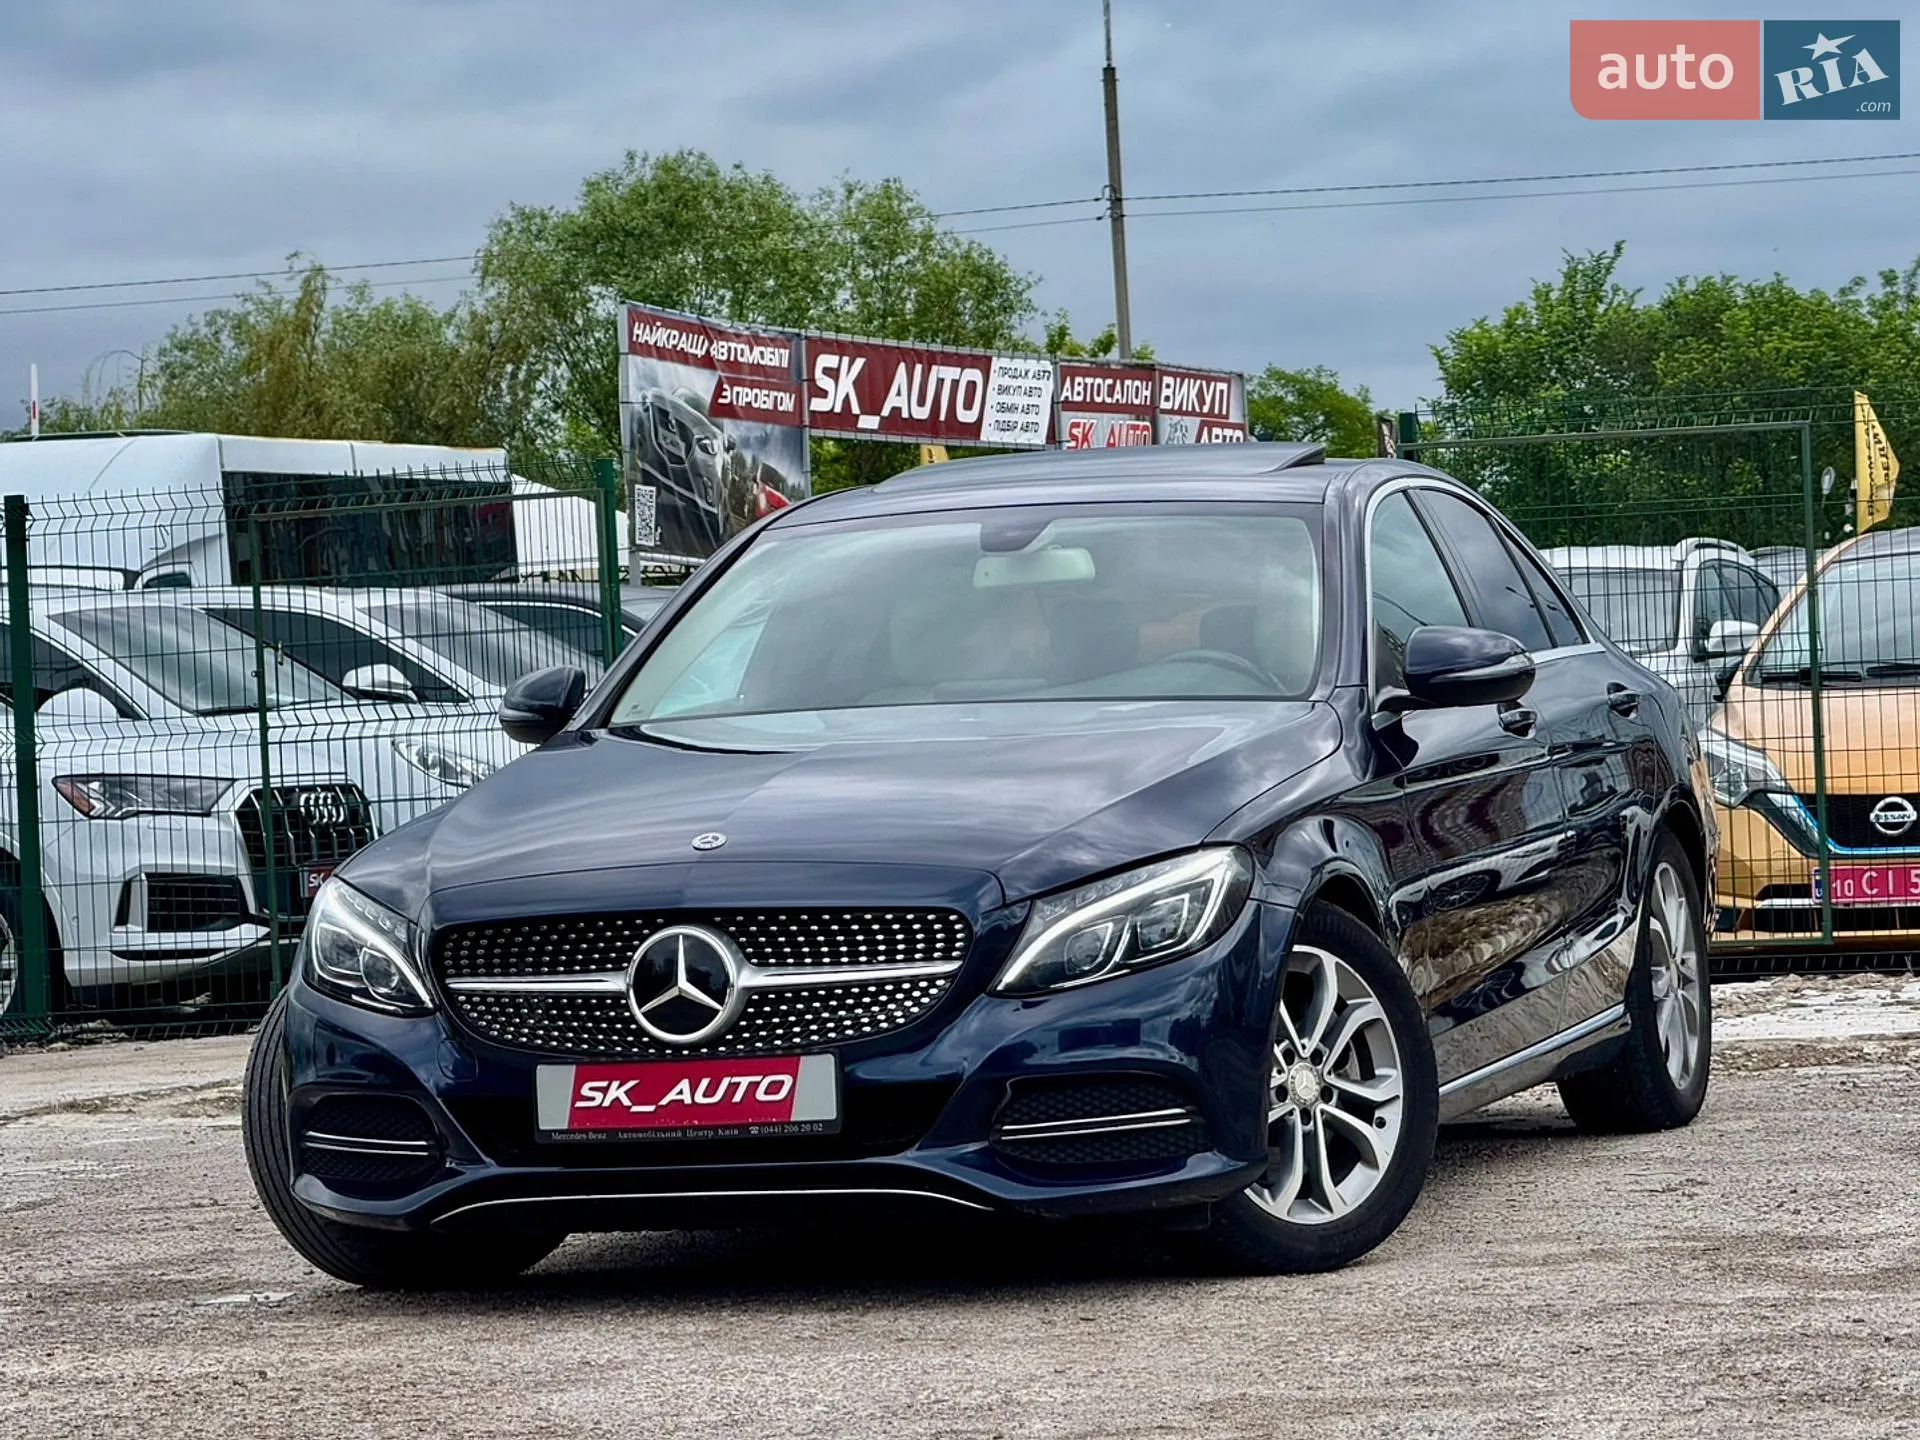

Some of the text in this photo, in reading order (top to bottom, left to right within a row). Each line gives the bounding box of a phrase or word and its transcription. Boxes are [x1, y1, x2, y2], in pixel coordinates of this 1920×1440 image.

[632, 320, 790, 369] НАЙКРАЩІ АВТОМОБІЛІ
[998, 366, 1030, 379] ПРОДАЖ
[717, 383, 796, 413] З ПРОБІГОМ
[809, 353, 984, 430] SK_AUTO
[997, 384, 1043, 398] ВИКУП АВТО
[1060, 375, 1152, 406] АВТОСАЛОН
[1159, 375, 1229, 415] ВИКУП
[995, 401, 1040, 416] ОБМІН АВТО
[993, 419, 1040, 433] ПІДБІР АВТО
[574, 1073, 793, 1113] SK_AUTO
